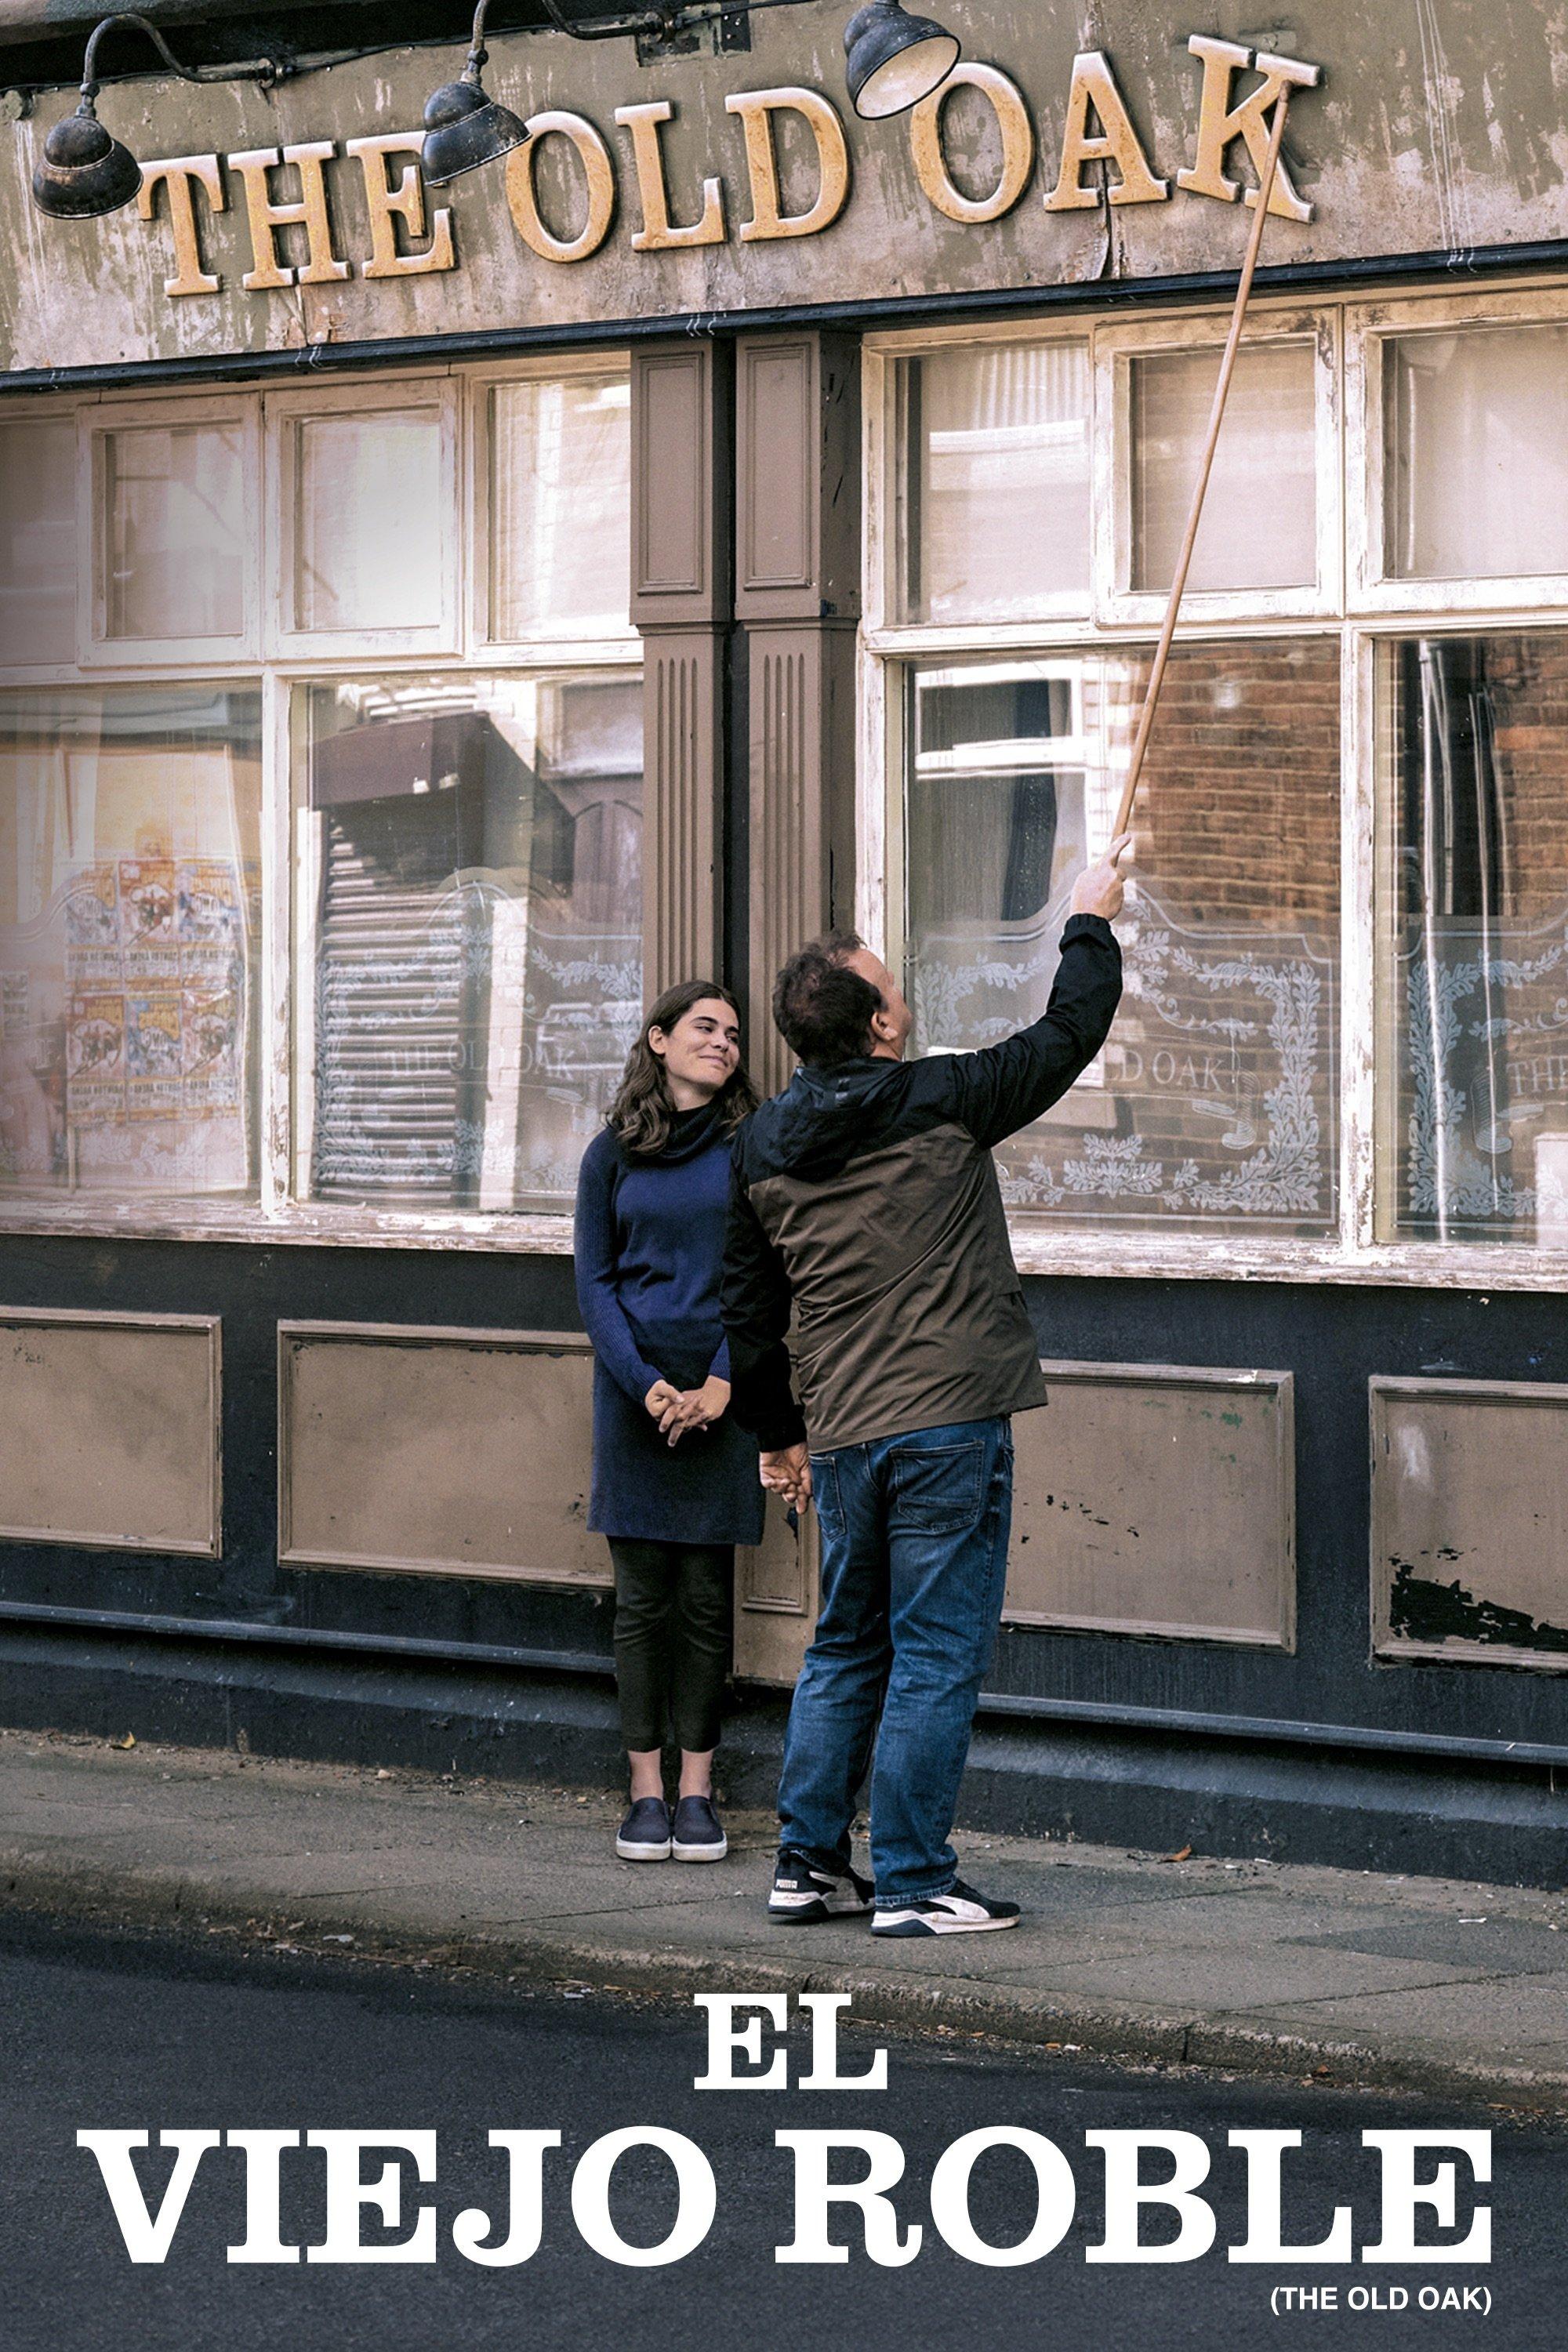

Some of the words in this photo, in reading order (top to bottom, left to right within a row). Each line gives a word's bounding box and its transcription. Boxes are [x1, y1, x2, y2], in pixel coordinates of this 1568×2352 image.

[138, 131, 458, 297] THE
[506, 86, 850, 263] OLD
[911, 34, 1321, 224] OAK
[1152, 1051, 1223, 1093] OAK
